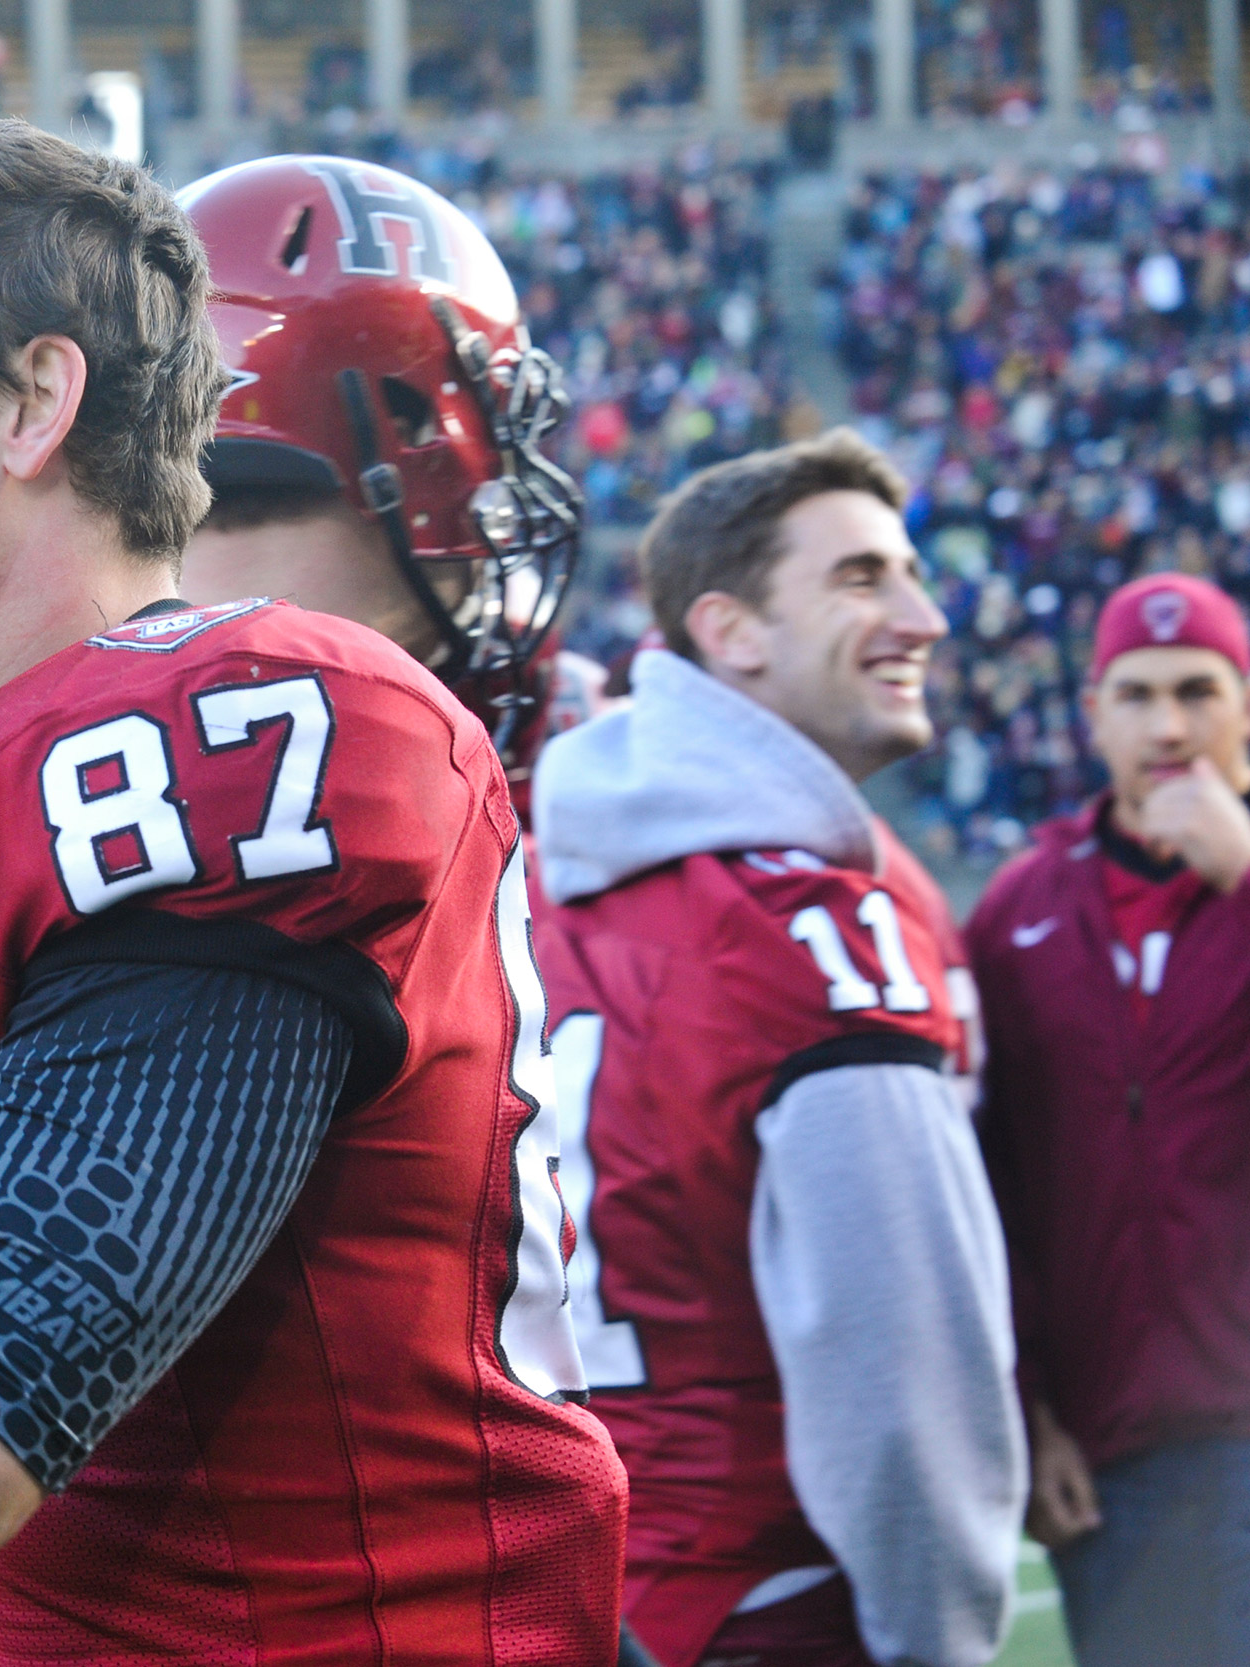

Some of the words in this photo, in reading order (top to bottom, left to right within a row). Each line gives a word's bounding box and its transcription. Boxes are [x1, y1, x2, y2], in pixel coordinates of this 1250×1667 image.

[38, 672, 341, 916] 87
[788, 889, 931, 1012] 11
[31, 1258, 133, 1346] PRO
